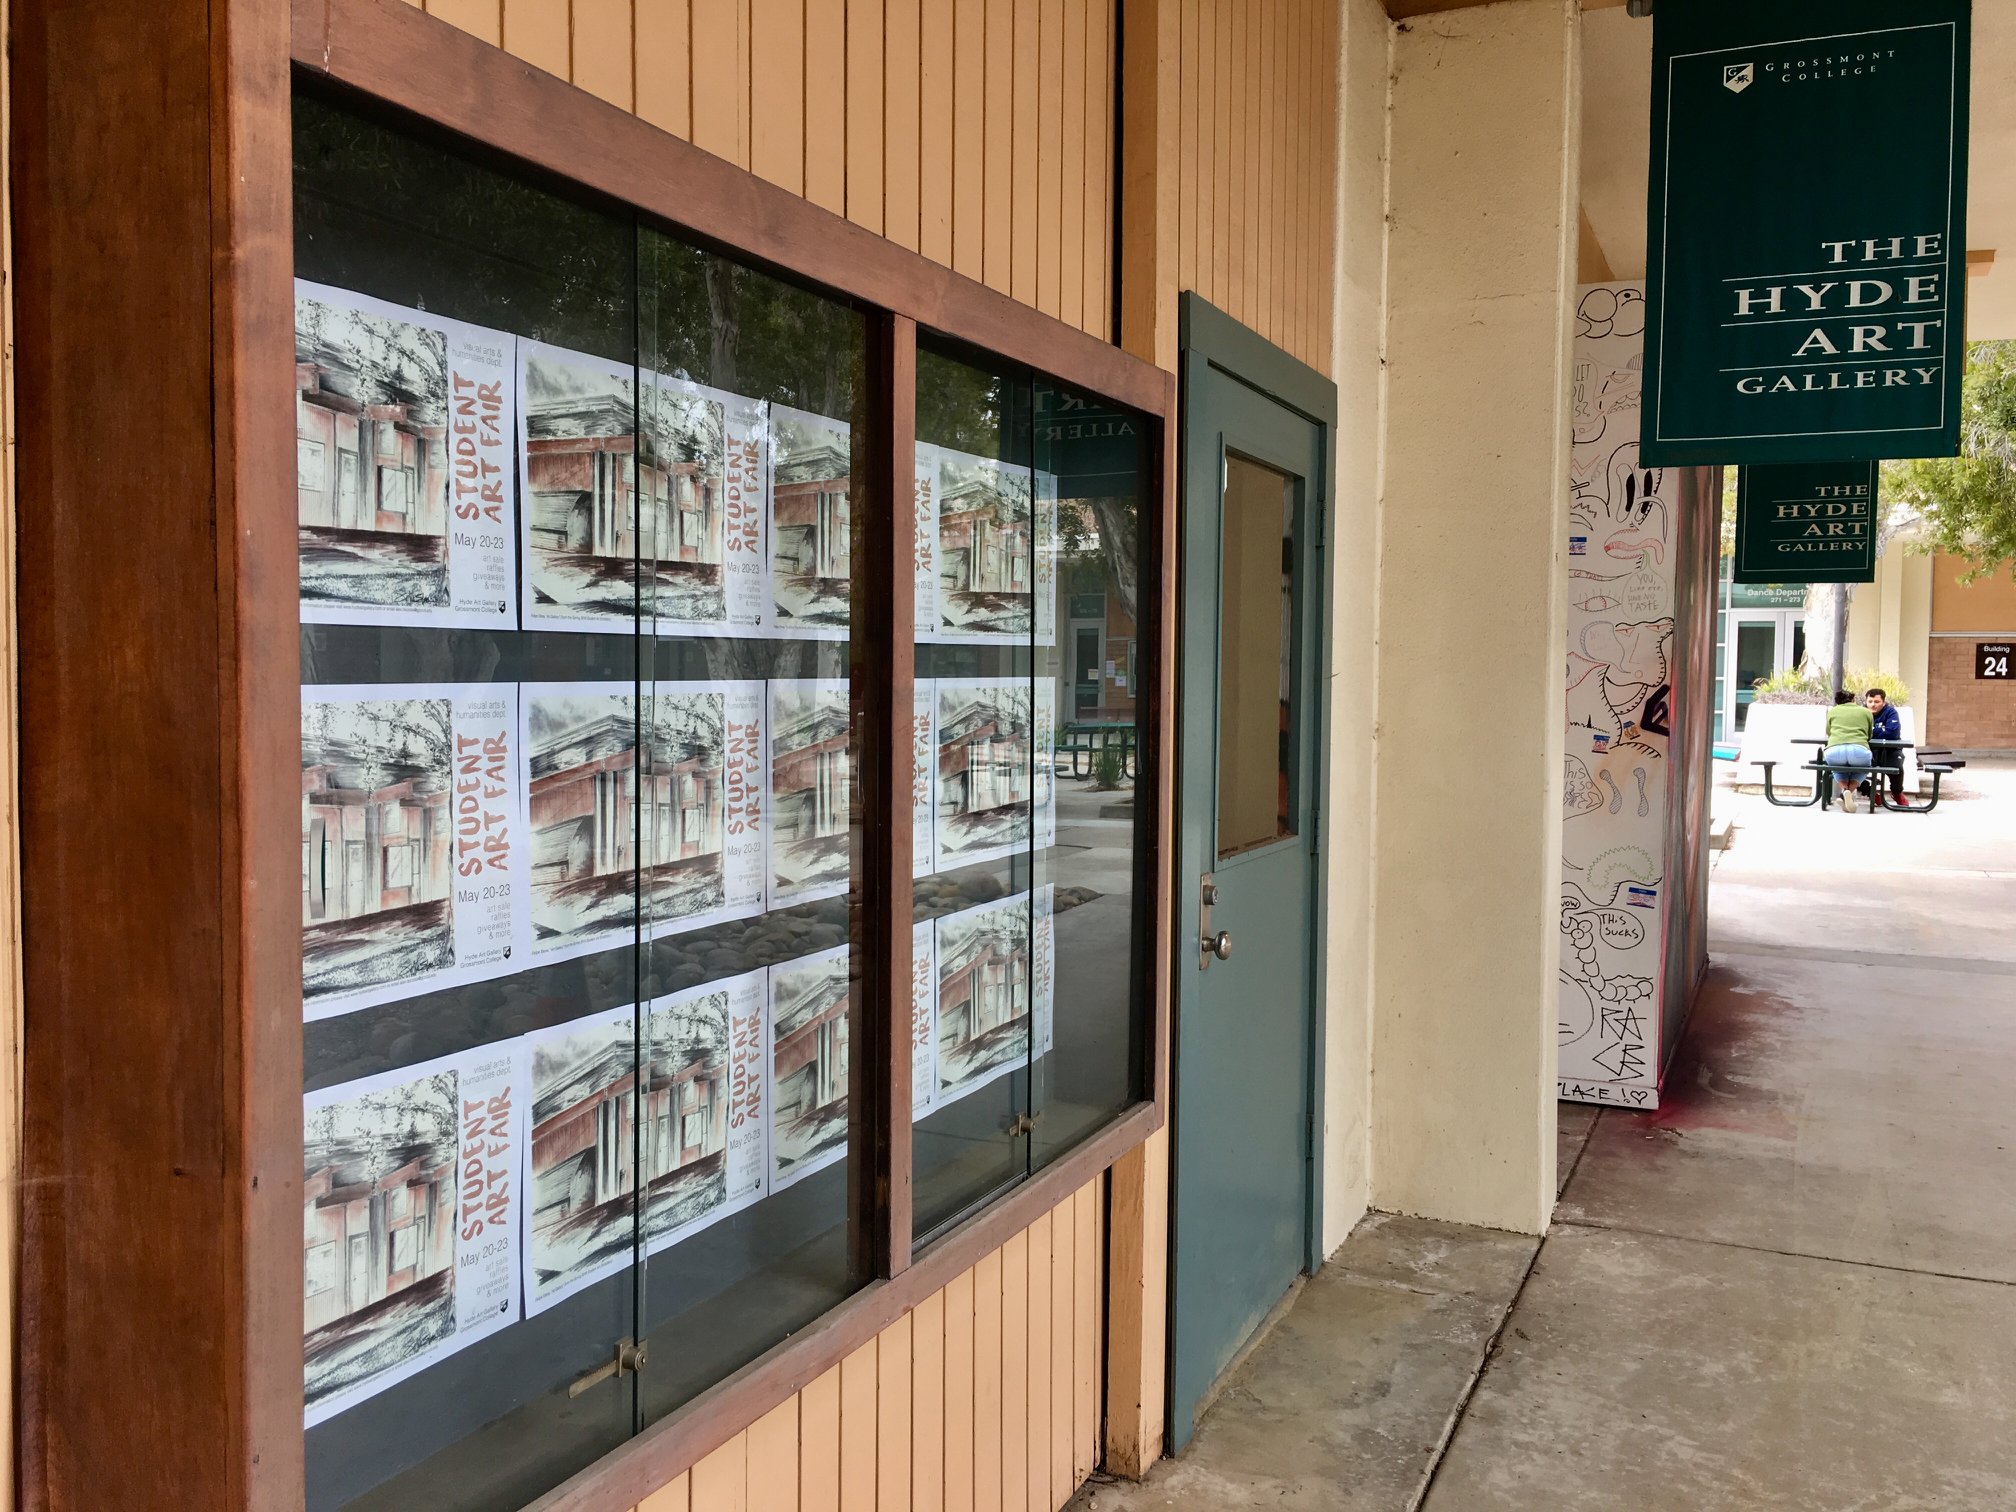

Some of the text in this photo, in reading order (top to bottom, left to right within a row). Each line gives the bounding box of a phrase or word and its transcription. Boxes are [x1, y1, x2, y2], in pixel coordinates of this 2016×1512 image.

[1765, 50, 1895, 72] GROSSMONT
[1782, 65, 1877, 83] COLLEGE
[1821, 233, 1942, 264] THE
[1733, 273, 1940, 316] HYDE
[1791, 319, 1942, 357] ART
[1736, 366, 1942, 394] GALLERY
[453, 370, 480, 521] STUDENT
[477, 380, 504, 525] ART FAIR
[743, 439, 760, 493] FAIR
[726, 433, 743, 553] STUDENT
[920, 477, 932, 524] FAIR
[1776, 502, 1868, 518] HYDE
[1815, 484, 1869, 497] THE
[454, 532, 504, 550] May 20-23
[743, 501, 759, 554] ART
[1777, 541, 1867, 552] GALLERY
[1802, 521, 1868, 537] ART
[727, 561, 760, 575] May 20-23
[919, 531, 932, 573] ART
[1747, 589, 1774, 597] Dance
[1983, 645, 2010, 654] Building
[1983, 656, 2008, 677] 24
[918, 710, 931, 756] FAIR
[727, 720, 745, 836] STUDENT
[745, 718, 761, 832] ART FAIR
[917, 763, 929, 806] ART
[456, 733, 483, 877] STUDENT
[482, 730, 511, 871] ART FAIR
[727, 845, 742, 857] May
[458, 883, 511, 904] May 20-23
[917, 951, 930, 1046] ART FAIR
[731, 1015, 748, 1129] STUDENT
[745, 1006, 761, 1119] ART FAIR
[1557, 1081, 1620, 1103] LACE
[485, 1085, 512, 1225] ART FAIR
[729, 1139, 742, 1150] May
[461, 1099, 486, 1242] STUDENT
[460, 1237, 509, 1269] May 20-23
